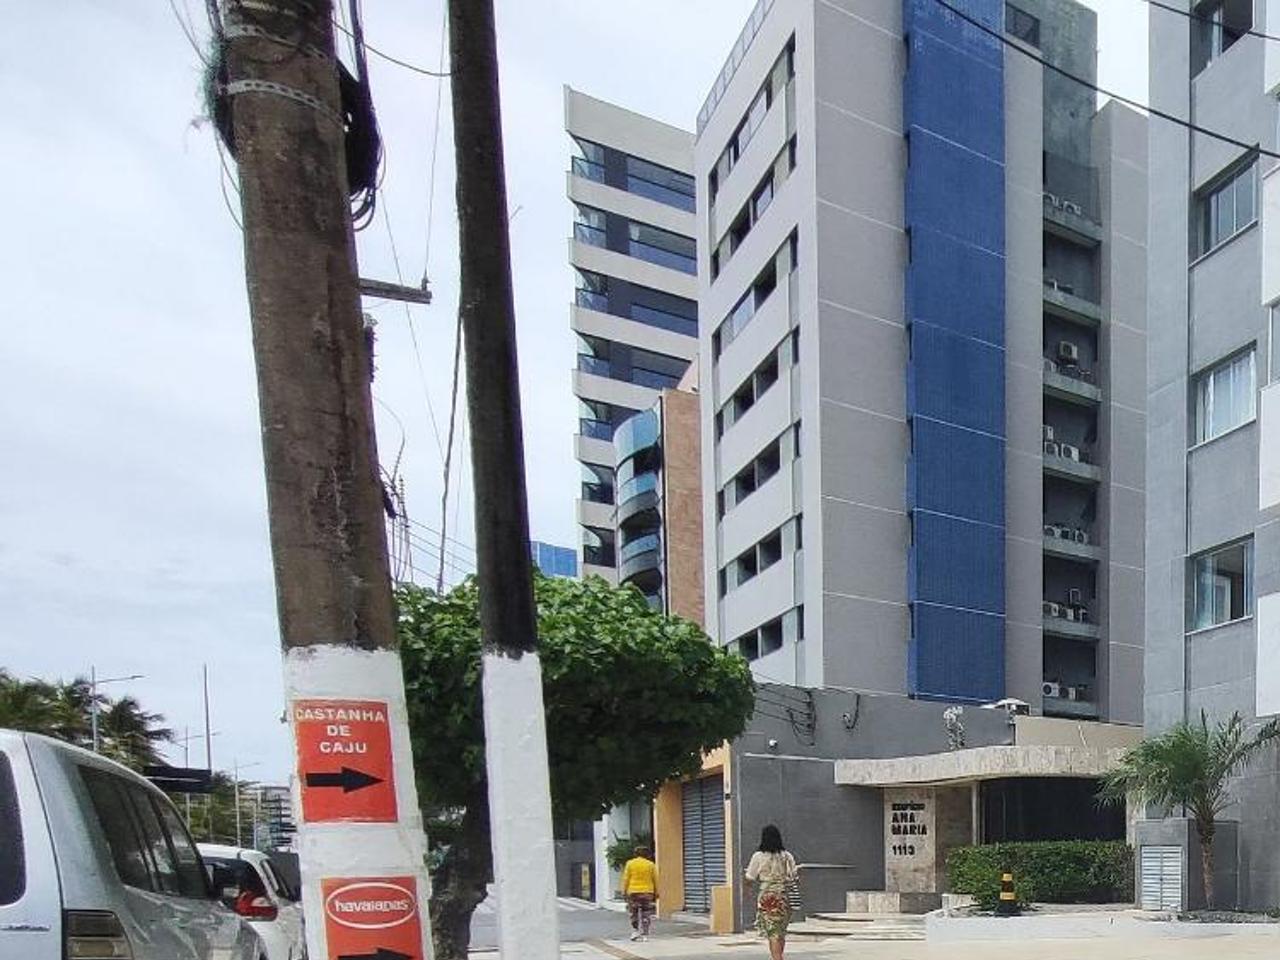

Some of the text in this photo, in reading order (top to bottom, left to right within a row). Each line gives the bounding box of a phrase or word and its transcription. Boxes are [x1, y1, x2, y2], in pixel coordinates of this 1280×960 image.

[296, 708, 385, 723] CASTANHA
[327, 724, 353, 737] DE
[319, 741, 368, 754] CAJU
[892, 812, 916, 823] ANA
[891, 824, 928, 836] MARIA
[892, 843, 916, 856] 1113
